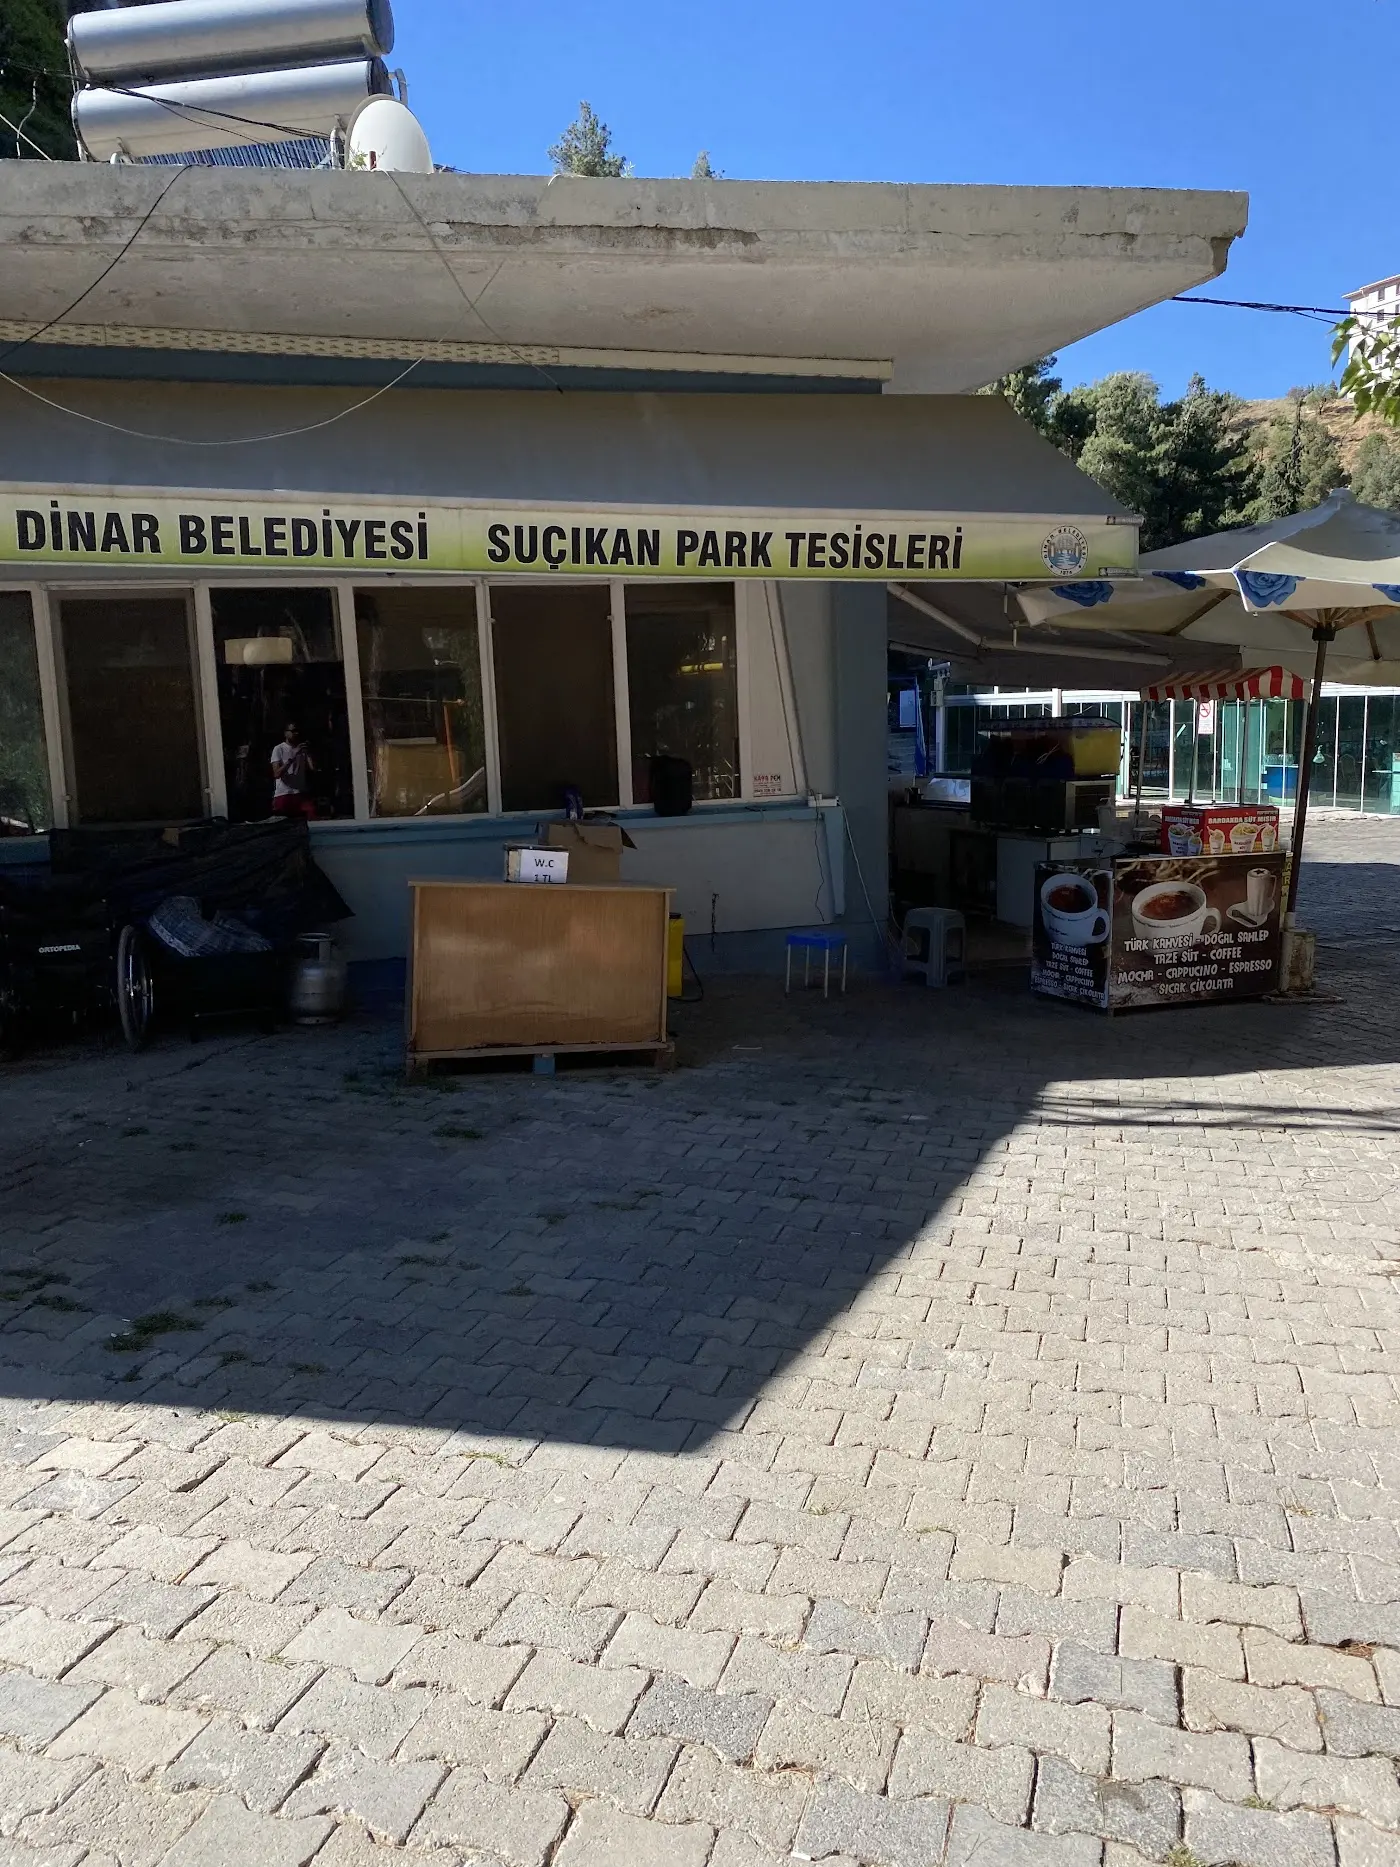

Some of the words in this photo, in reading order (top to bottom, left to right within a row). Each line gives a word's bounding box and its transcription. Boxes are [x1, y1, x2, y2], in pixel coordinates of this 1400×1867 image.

[16, 500, 162, 554] DİNAR
[178, 509, 429, 560] BELEDİYESİ
[487, 523, 660, 571] SUÇIKAN
[675, 529, 774, 569] PARK
[784, 523, 963, 570] TESİSLERİ
[534, 857, 555, 868] W.C
[534, 873, 540, 883] 1
[542, 873, 553, 883] TL
[38, 944, 81, 953] ORTOPEDIA
[1124, 937, 1149, 952] TÜRK
[1152, 932, 1194, 950] KAHVESİ
[1203, 931, 1234, 946] DOĞAL
[1237, 929, 1270, 943] SAHLEP
[1154, 951, 1179, 964] TAZE
[1180, 949, 1200, 963] SÜT
[1209, 946, 1243, 961] COFFEE
[1074, 967, 1094, 978] COFFEE
[1117, 970, 1154, 985] MOCHA
[1165, 963, 1218, 980] CAPPUCINO
[1228, 959, 1273, 974] ESPRESSO
[1158, 981, 1187, 995] SICAK
[1190, 978, 1234, 993] ÇİKOLATA
